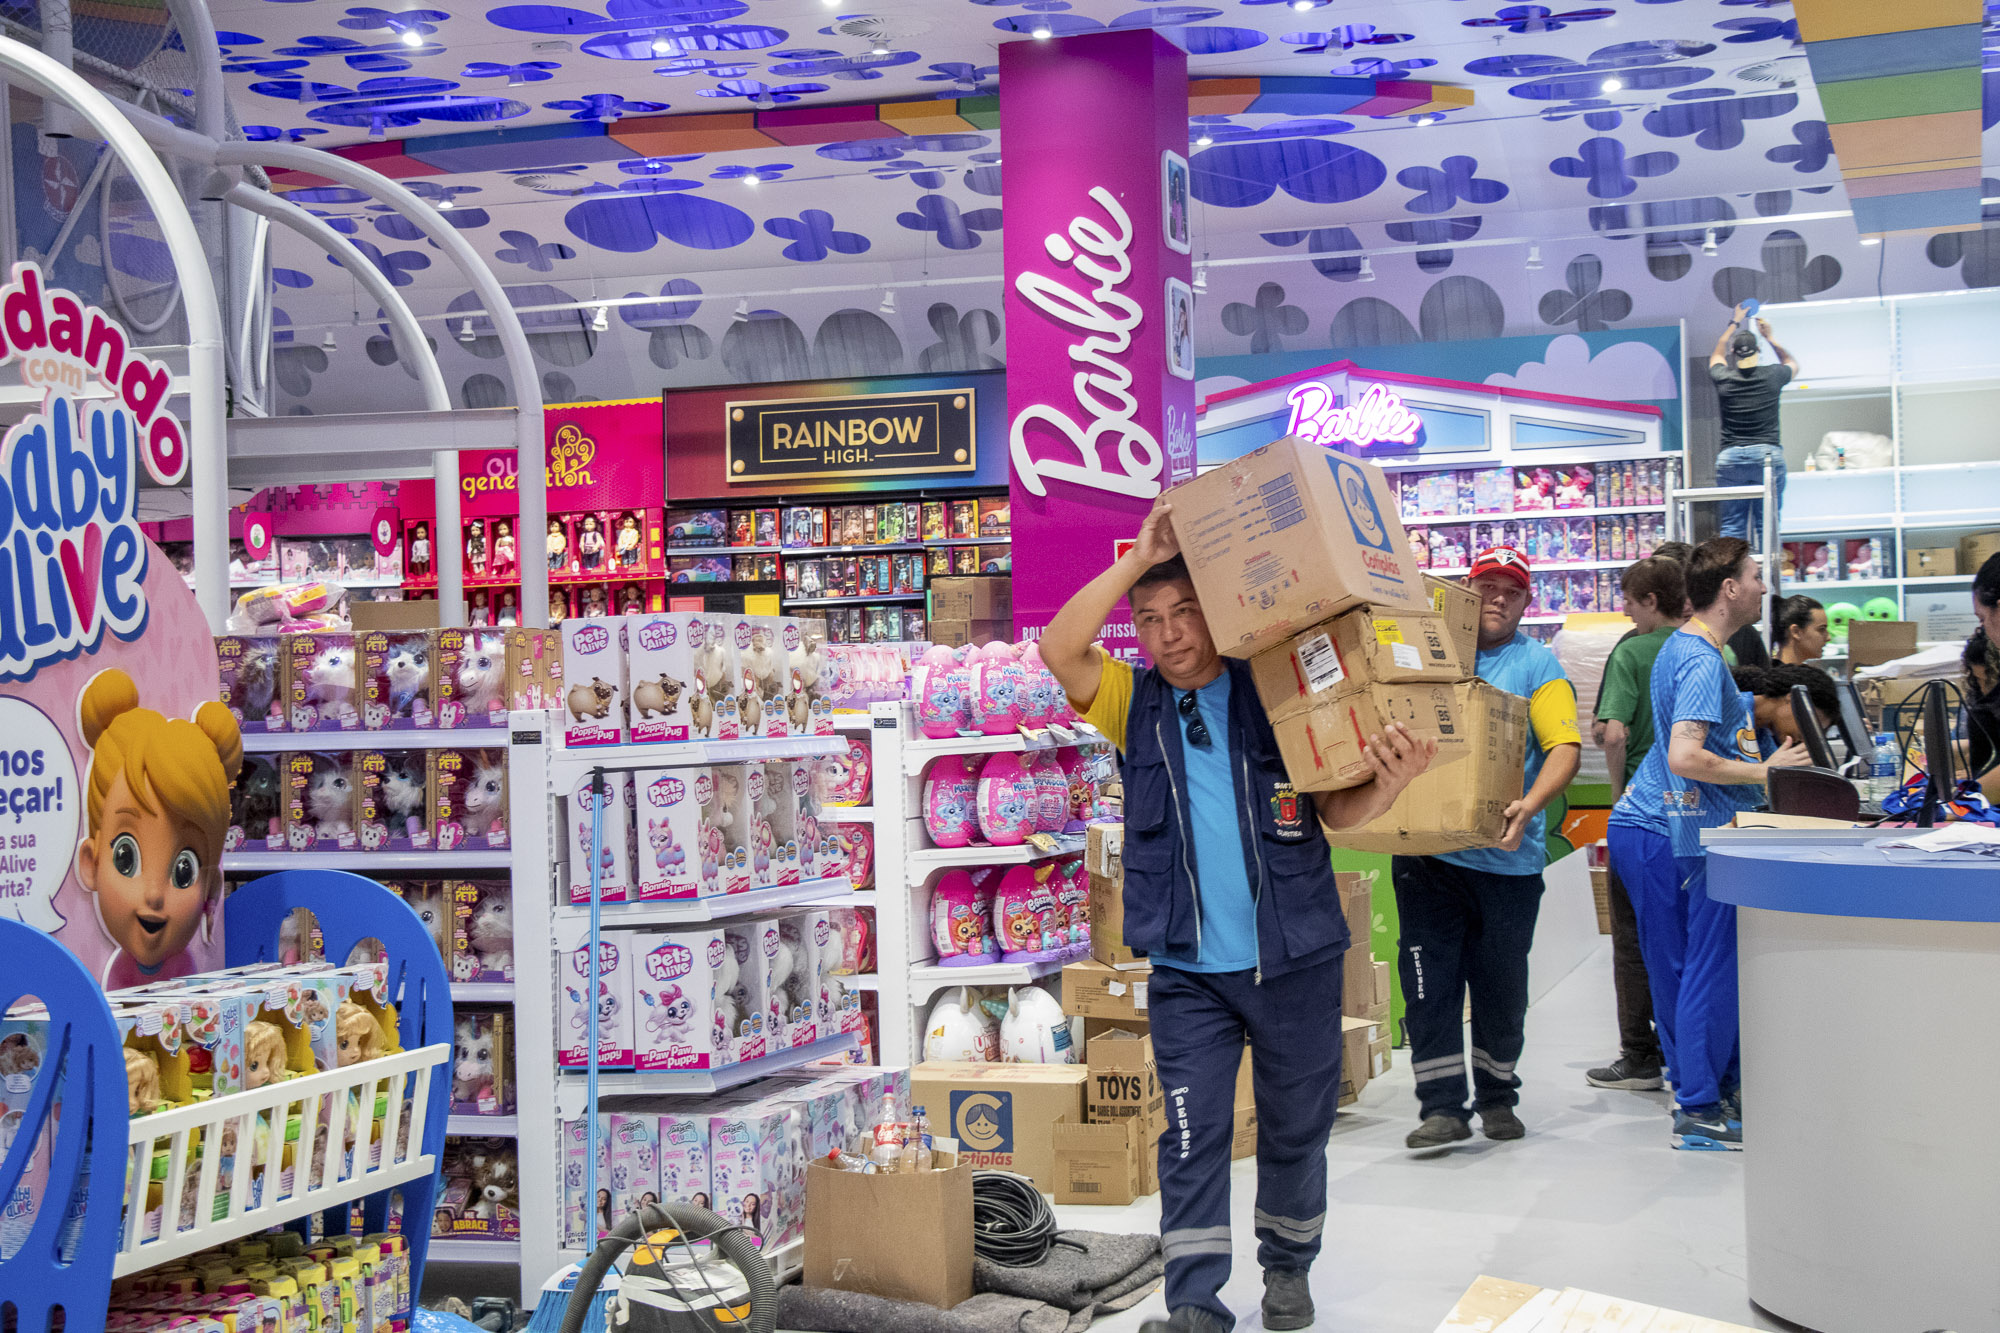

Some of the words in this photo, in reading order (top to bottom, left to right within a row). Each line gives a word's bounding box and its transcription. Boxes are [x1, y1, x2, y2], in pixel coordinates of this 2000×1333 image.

[1010, 185, 1164, 499] Barbie
[0, 269, 183, 477] dando
[29, 358, 83, 391] com
[1287, 381, 1422, 447] Barbie
[773, 415, 923, 450] RAINBOW
[824, 449, 868, 465] HIGH
[487, 457, 519, 477] OU
[573, 628, 608, 651] Pets
[640, 623, 676, 647] Pets
[293, 643, 315, 655] PETS
[366, 641, 388, 652] PETS
[440, 637, 464, 650] PETS
[580, 640, 608, 656] Alive
[647, 636, 675, 652] Alive
[571, 725, 599, 738] Poppy
[597, 730, 615, 741] Pug
[638, 721, 667, 734] Poppy
[664, 726, 683, 737] Pug
[363, 760, 386, 772] PETS
[438, 758, 463, 770] PETS
[648, 780, 684, 804] Pets
[656, 791, 684, 808] Alive
[11, 833, 37, 849] sua
[642, 879, 672, 893] Bonnie
[669, 882, 696, 895] Llama
[455, 890, 479, 903] PETS
[575, 946, 617, 972] Pts
[647, 947, 691, 975] Pets
[656, 961, 691, 981] Alive
[598, 1050, 622, 1062] uppy
[649, 1050, 670, 1061] Paw
[670, 1045, 692, 1057] Paw
[667, 1053, 698, 1069] Puppy
[1097, 1075, 1142, 1101] TOYS
[958, 1151, 1012, 1169] otiplás
[453, 1220, 489, 1231] ABRACE
